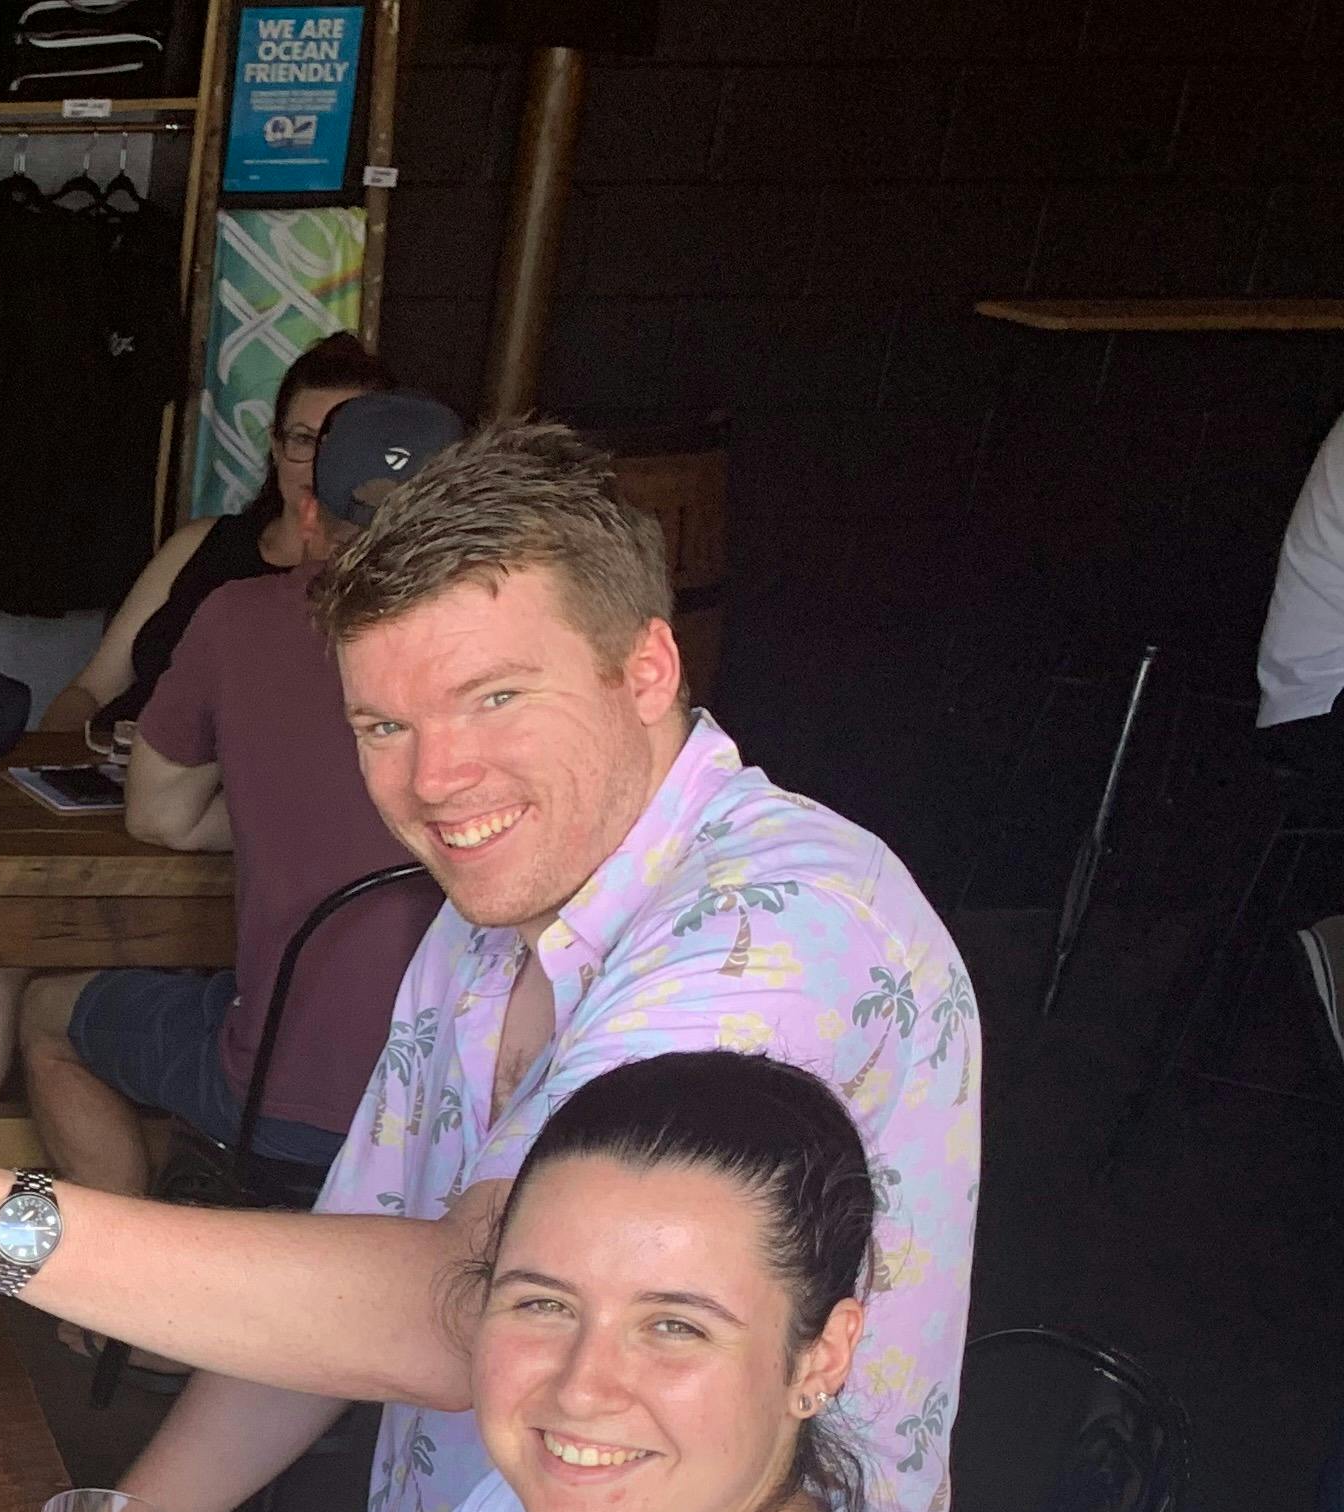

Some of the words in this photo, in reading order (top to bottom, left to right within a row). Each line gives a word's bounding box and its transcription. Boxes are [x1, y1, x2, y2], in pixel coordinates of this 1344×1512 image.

[258, 19, 296, 38] WE
[300, 18, 345, 38] ARE
[257, 41, 340, 61] OCEAN
[243, 61, 349, 83] FRIENDLY
